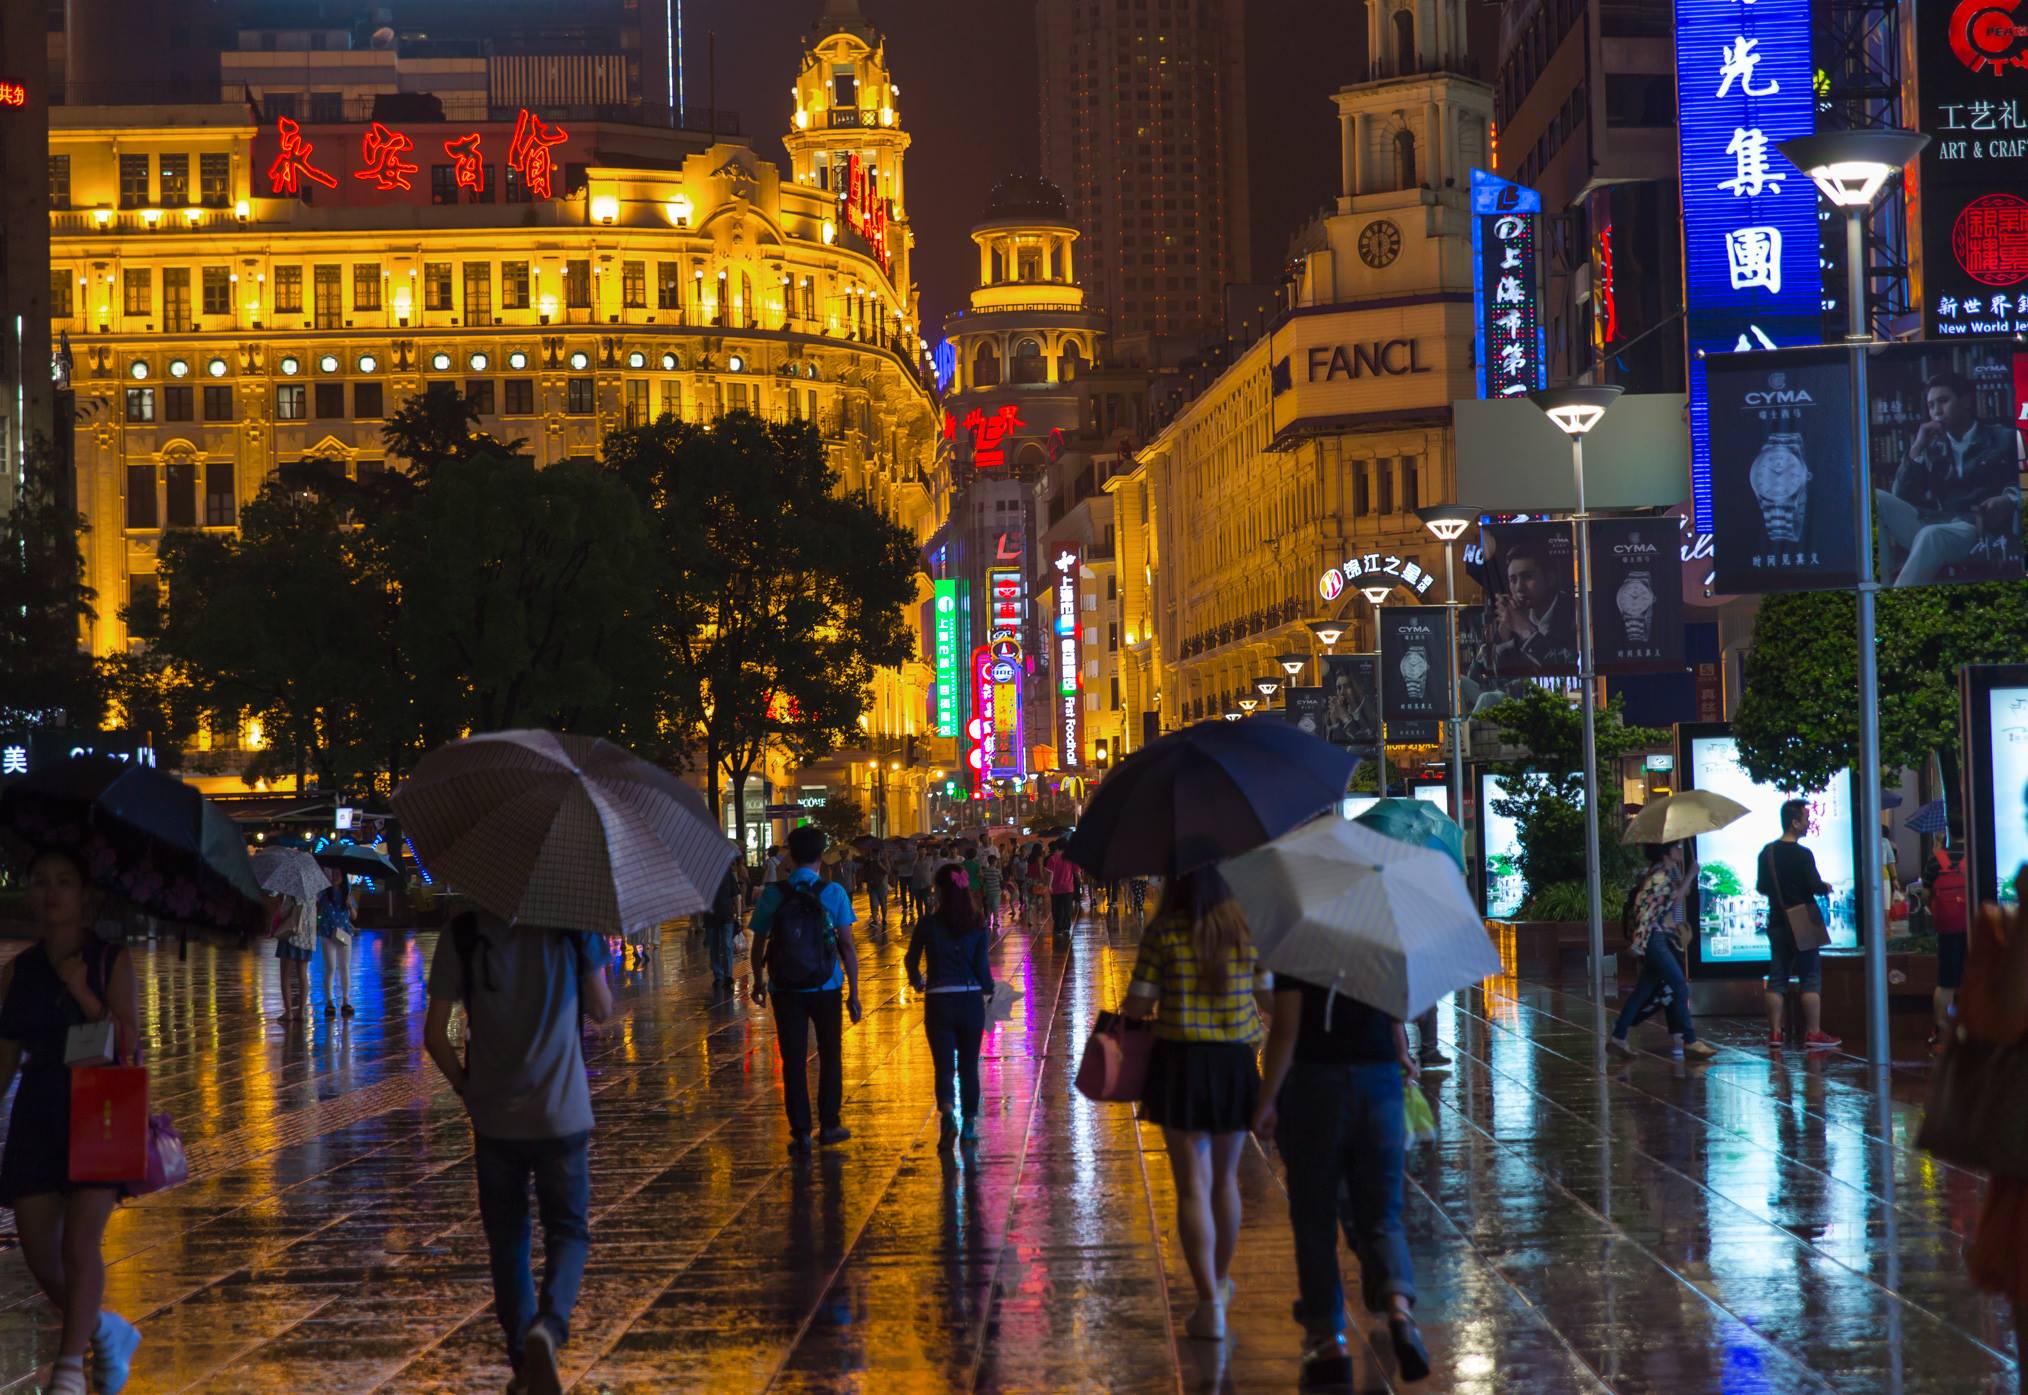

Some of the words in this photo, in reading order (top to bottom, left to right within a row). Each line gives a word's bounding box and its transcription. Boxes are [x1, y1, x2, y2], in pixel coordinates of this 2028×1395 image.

[1939, 140, 1967, 159] ART
[1973, 140, 1984, 158] &
[1989, 137, 2028, 158] CRAF
[1715, 0, 1788, 351] 光集團
[1938, 323, 1967, 335] New
[1970, 320, 2010, 333] World
[2013, 320, 2028, 332] Je
[1307, 339, 1432, 383] FANCL
[1974, 364, 2008, 374] CYMA
[1744, 389, 1813, 405] CYMA
[1613, 543, 1657, 554] CYMA
[1064, 696, 1076, 718] First
[1065, 718, 1078, 765] Foodhall
[3, 745, 28, 775] 美
